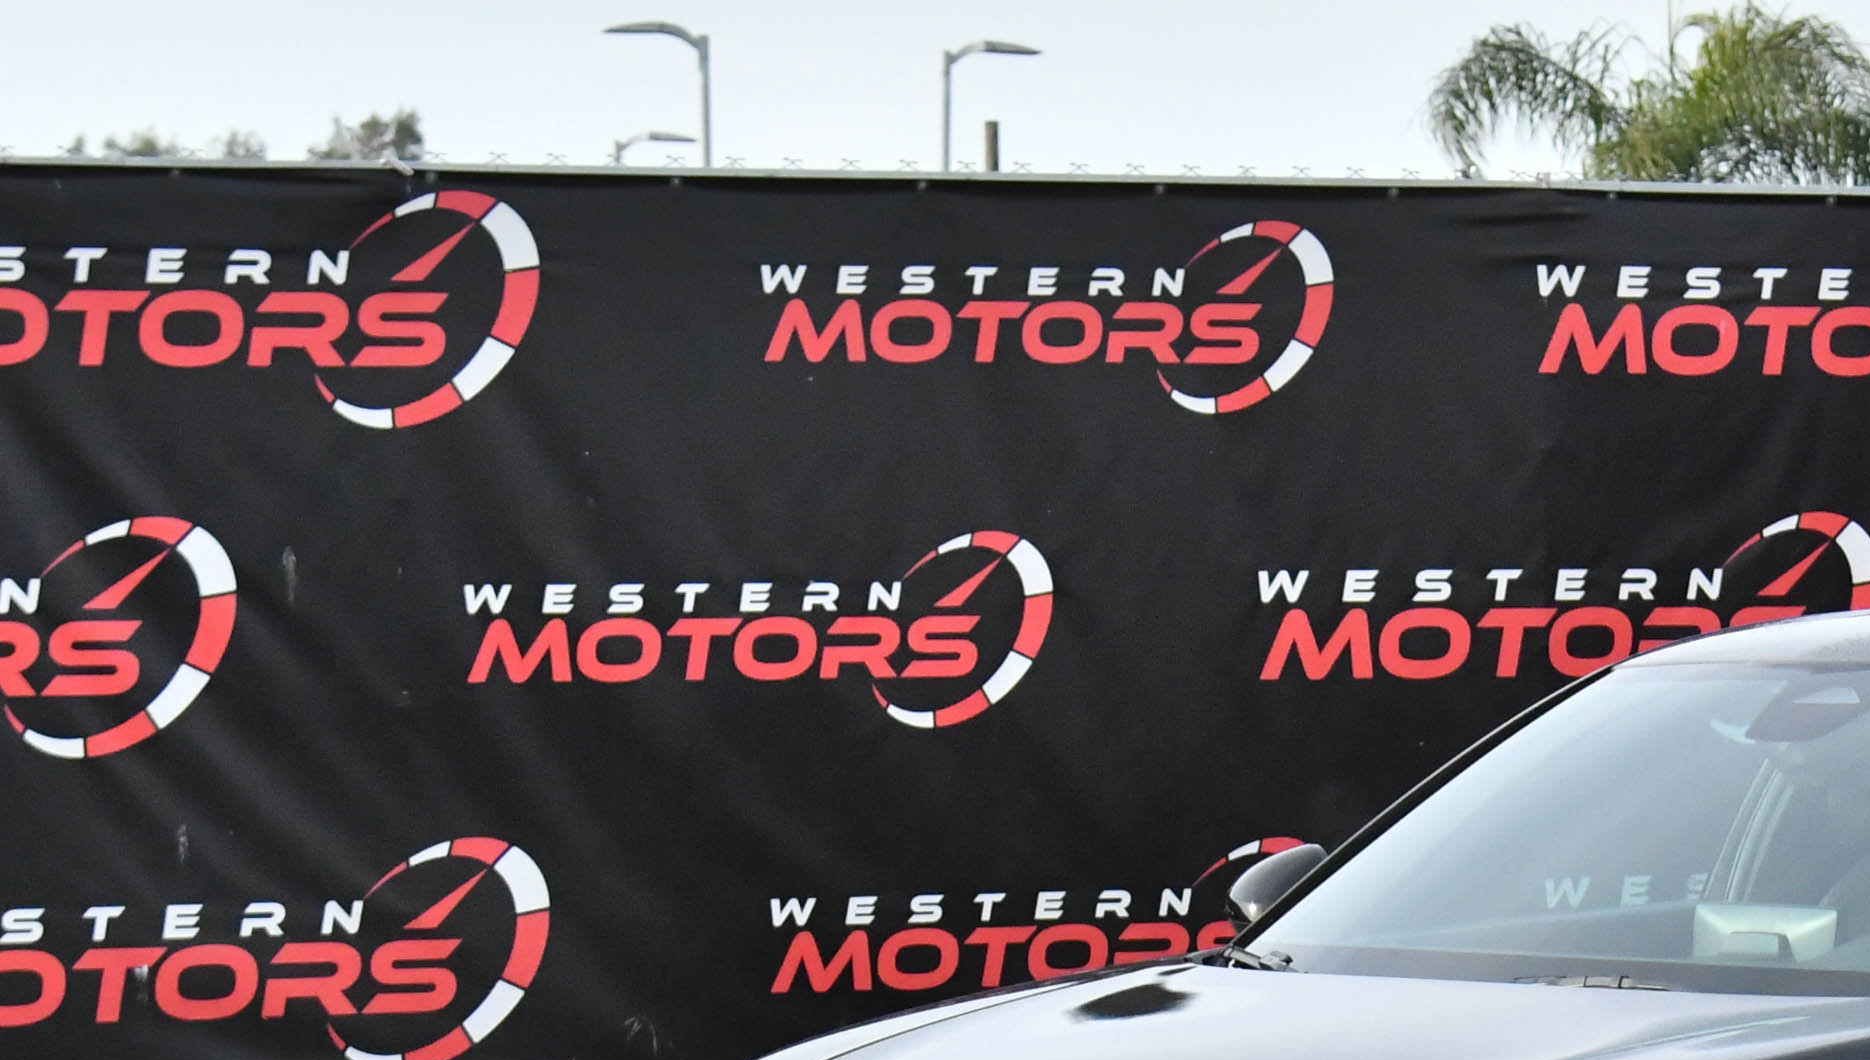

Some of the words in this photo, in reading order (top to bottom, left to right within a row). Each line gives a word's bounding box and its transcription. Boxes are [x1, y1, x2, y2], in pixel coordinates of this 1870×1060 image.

[762, 265, 1184, 296] WESTERN
[766, 299, 1261, 364] MOTORS
[464, 582, 901, 614] WESTERN
[1259, 569, 1722, 602] WESTERN
[468, 615, 979, 683] MOTORS
[771, 889, 1191, 926] WESTERN
[772, 921, 1235, 993] MOTOR
